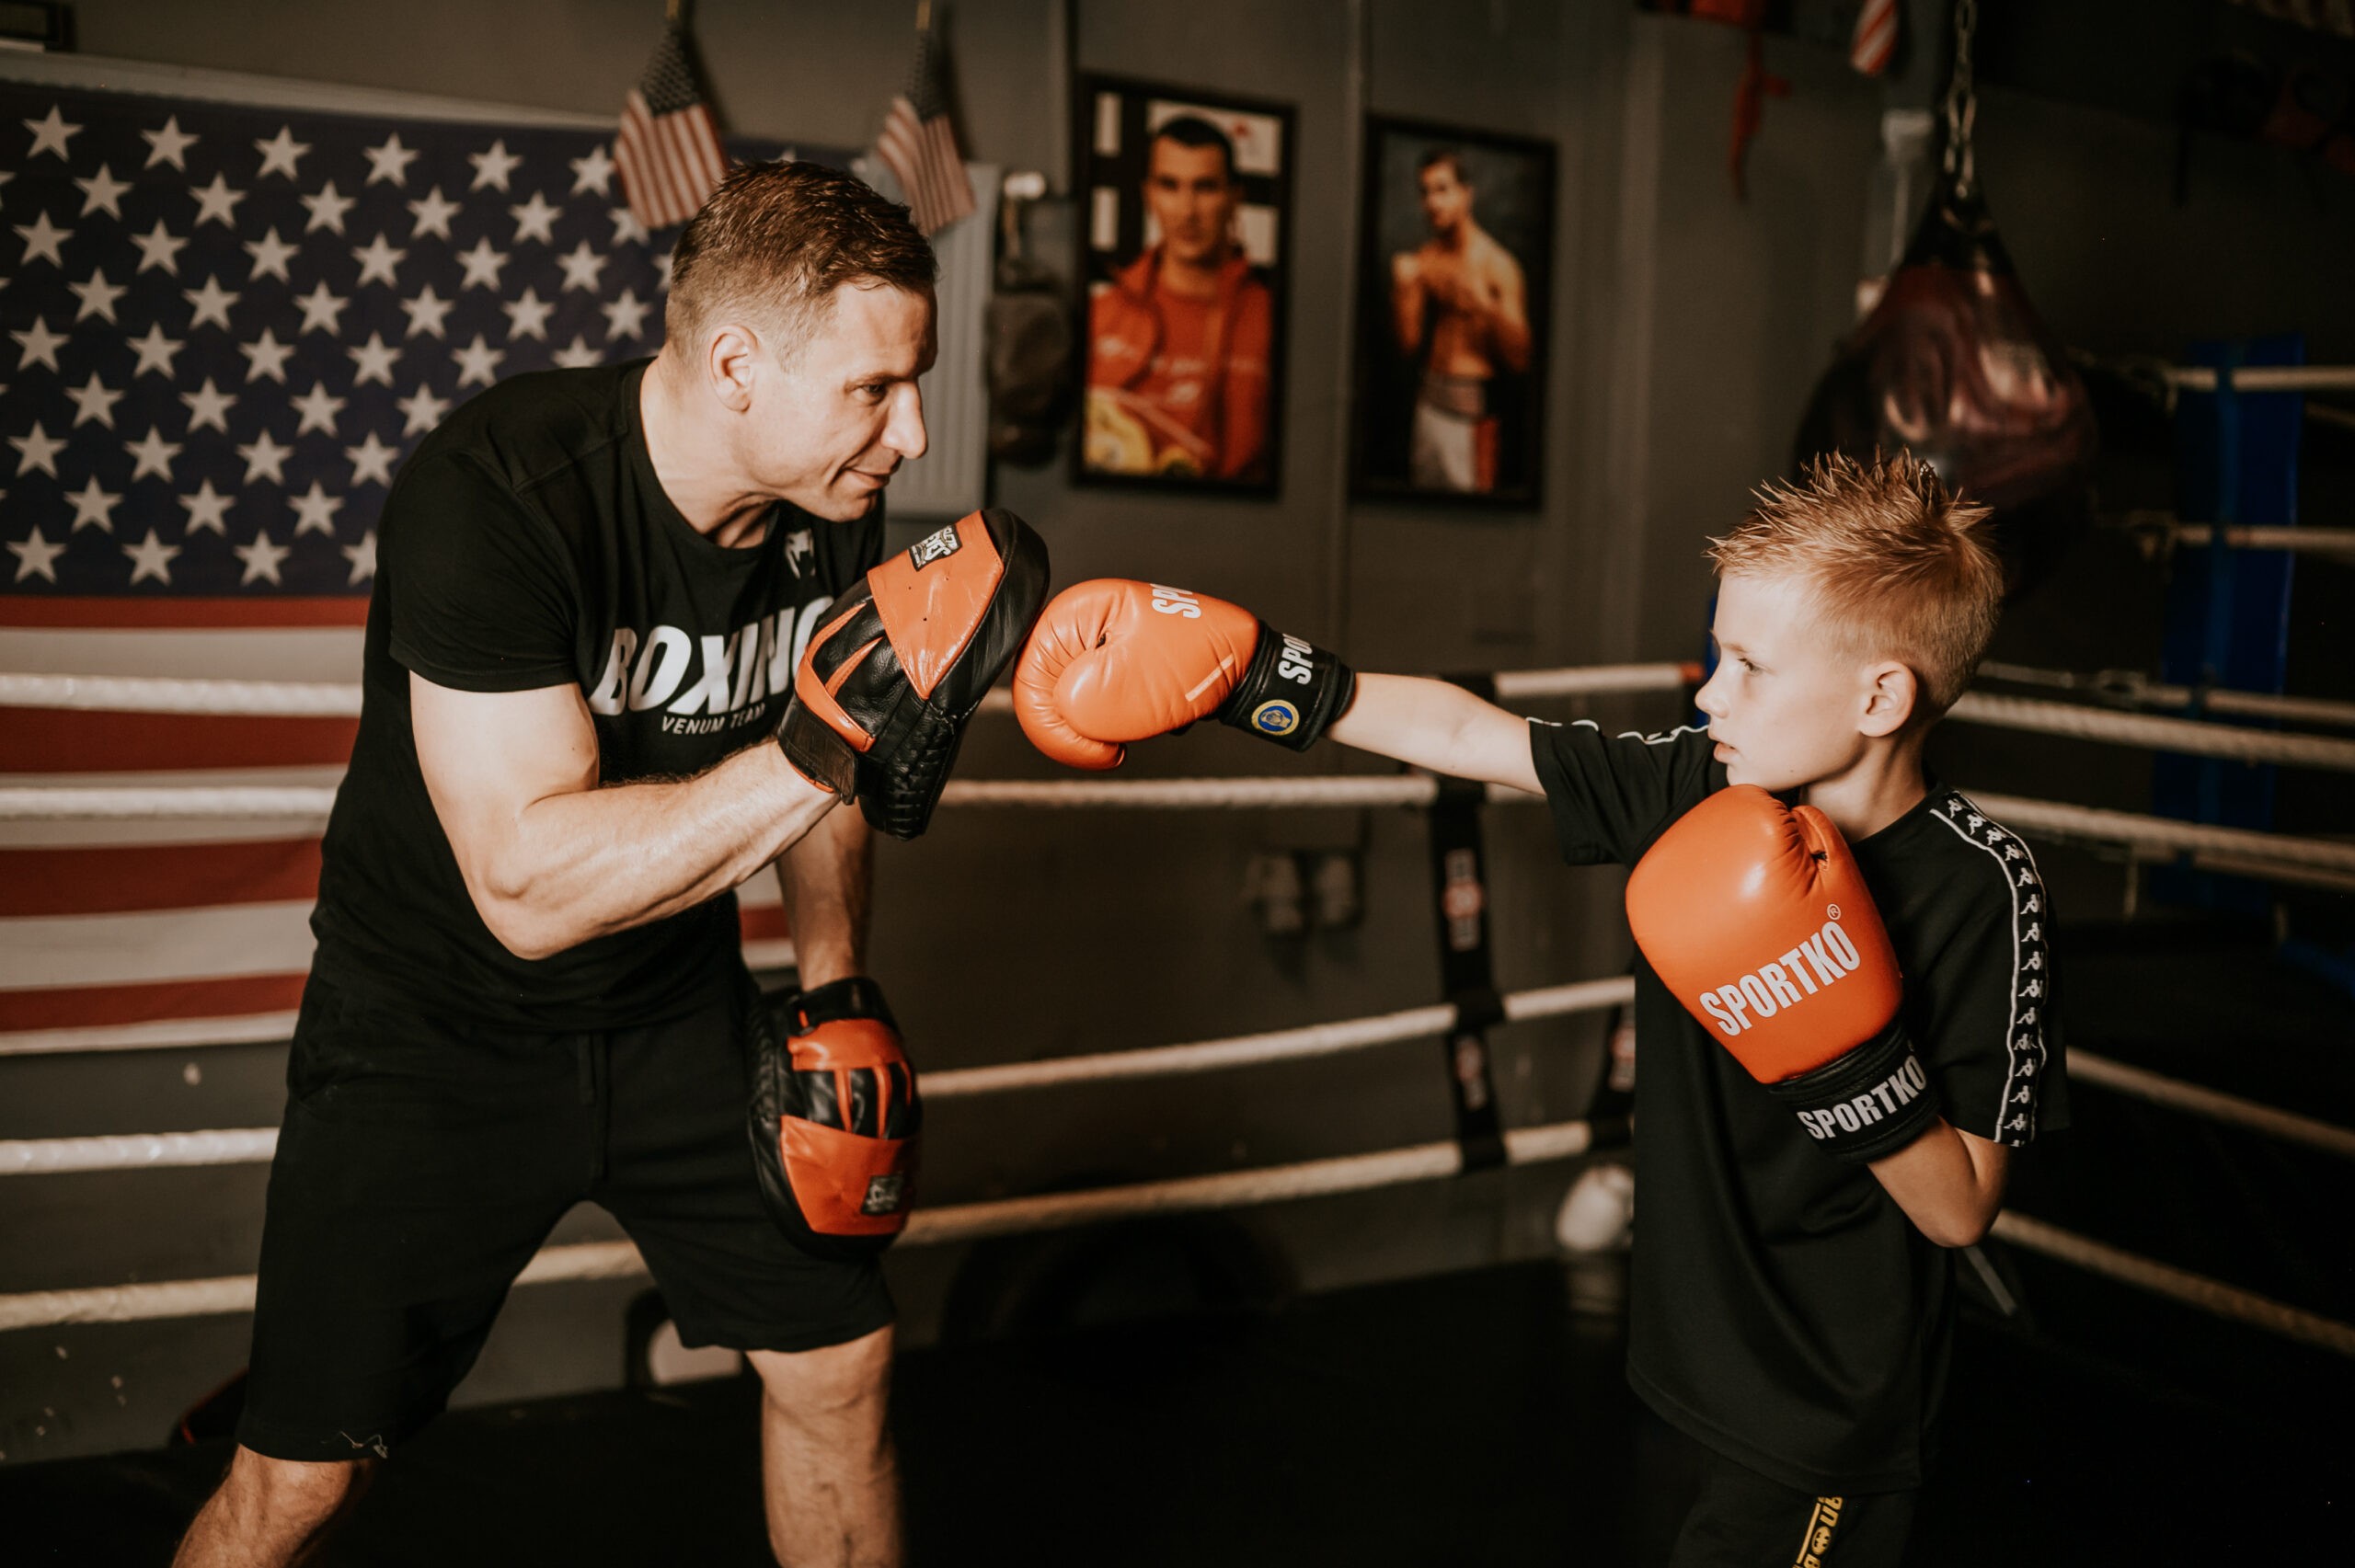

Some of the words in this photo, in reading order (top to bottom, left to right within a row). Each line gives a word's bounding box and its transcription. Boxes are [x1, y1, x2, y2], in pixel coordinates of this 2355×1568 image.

[1150, 583, 1201, 619] SP
[1278, 633, 1314, 685] SPO
[661, 715, 726, 735] VENUM
[1699, 921, 1861, 1036] SPORTKO
[1797, 1054, 1927, 1140] SPORTKO
